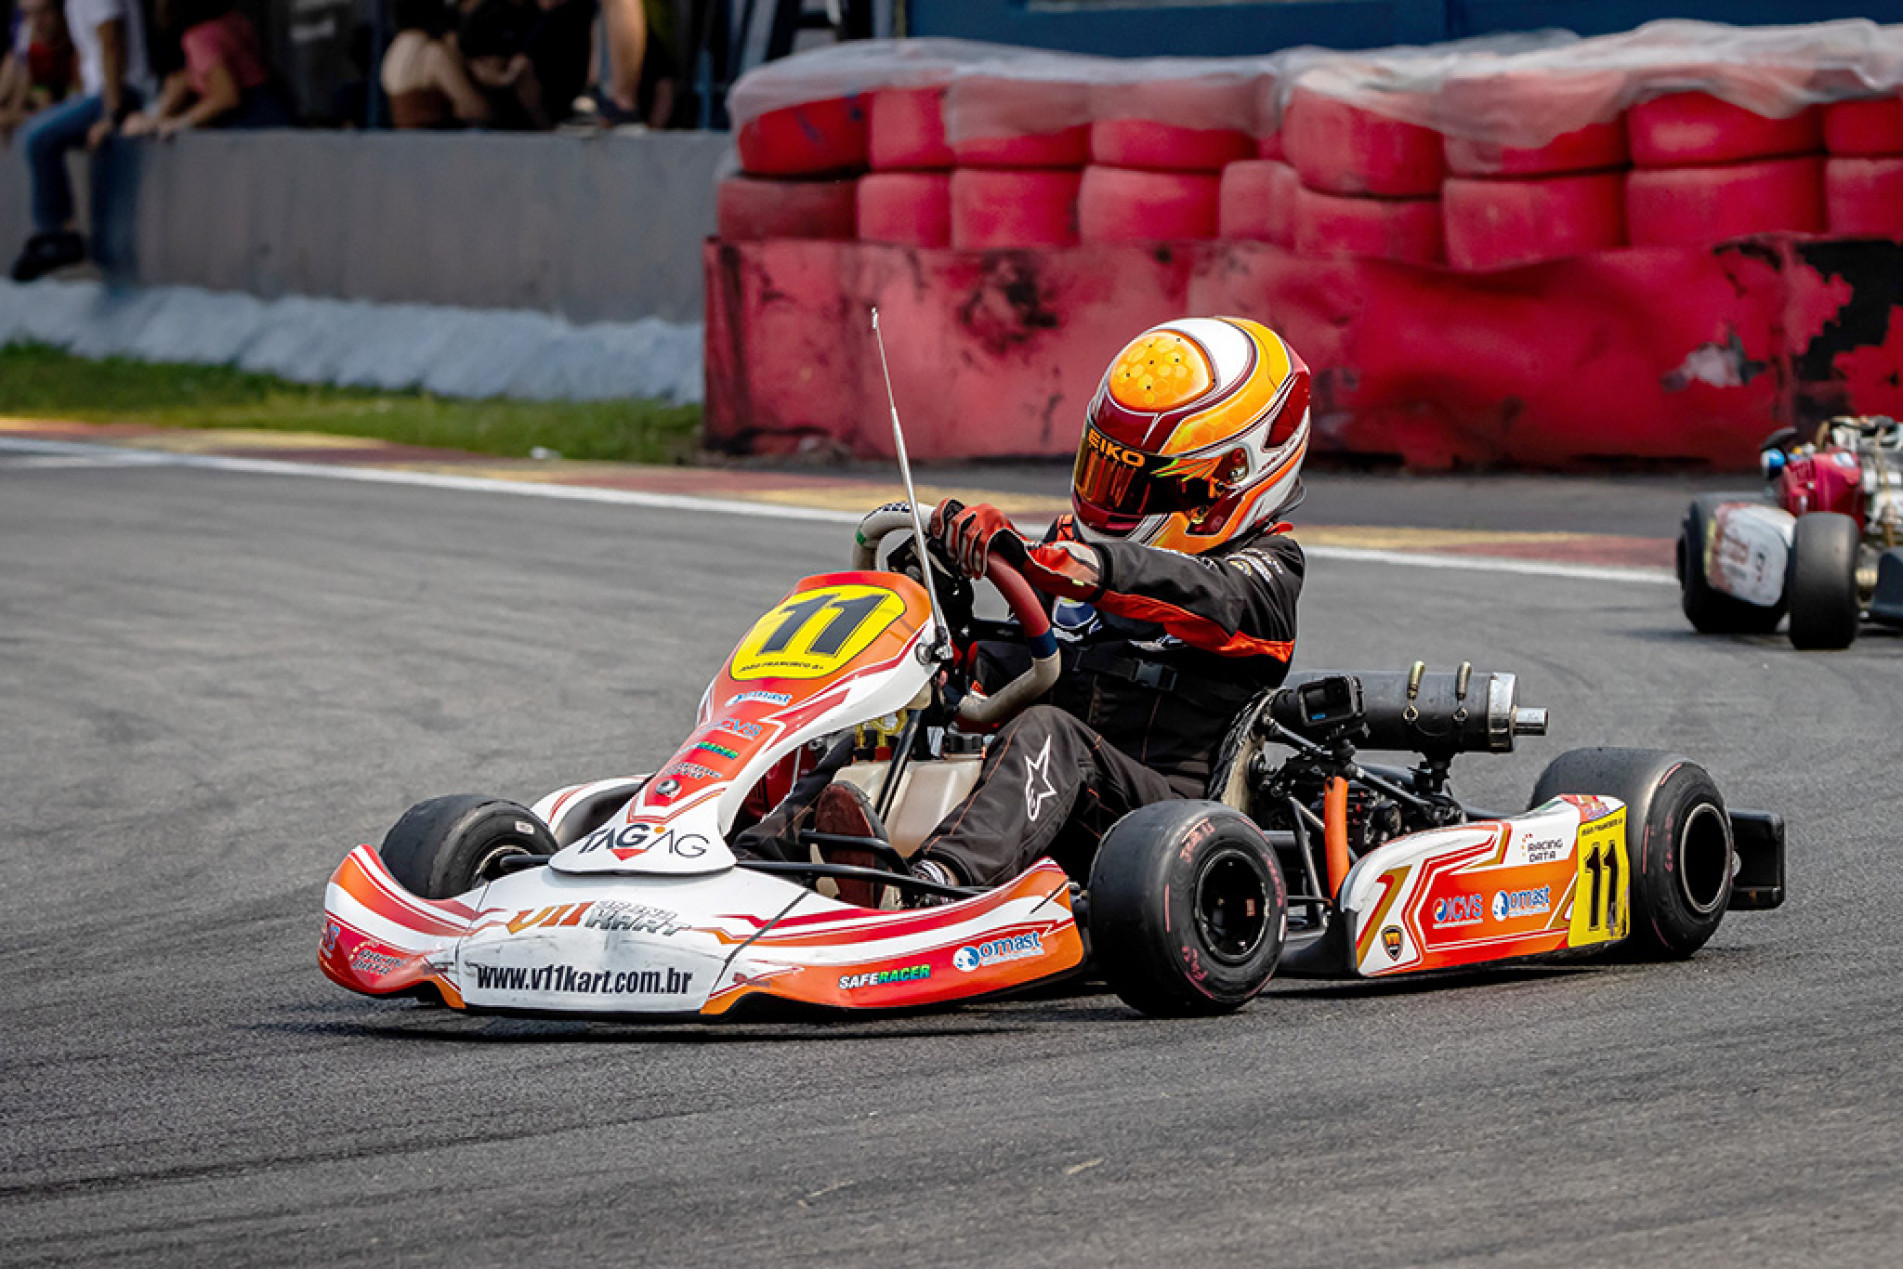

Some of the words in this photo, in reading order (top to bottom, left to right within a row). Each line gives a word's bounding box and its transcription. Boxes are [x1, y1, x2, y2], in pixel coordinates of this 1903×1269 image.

[755, 594, 889, 658] 11
[1528, 838, 1563, 851] RACING
[1529, 850, 1556, 862] DATA
[1509, 884, 1551, 909] omast
[1583, 840, 1618, 932] 11
[979, 931, 1042, 958] omast
[477, 963, 694, 995] www.v11kart.com.br
